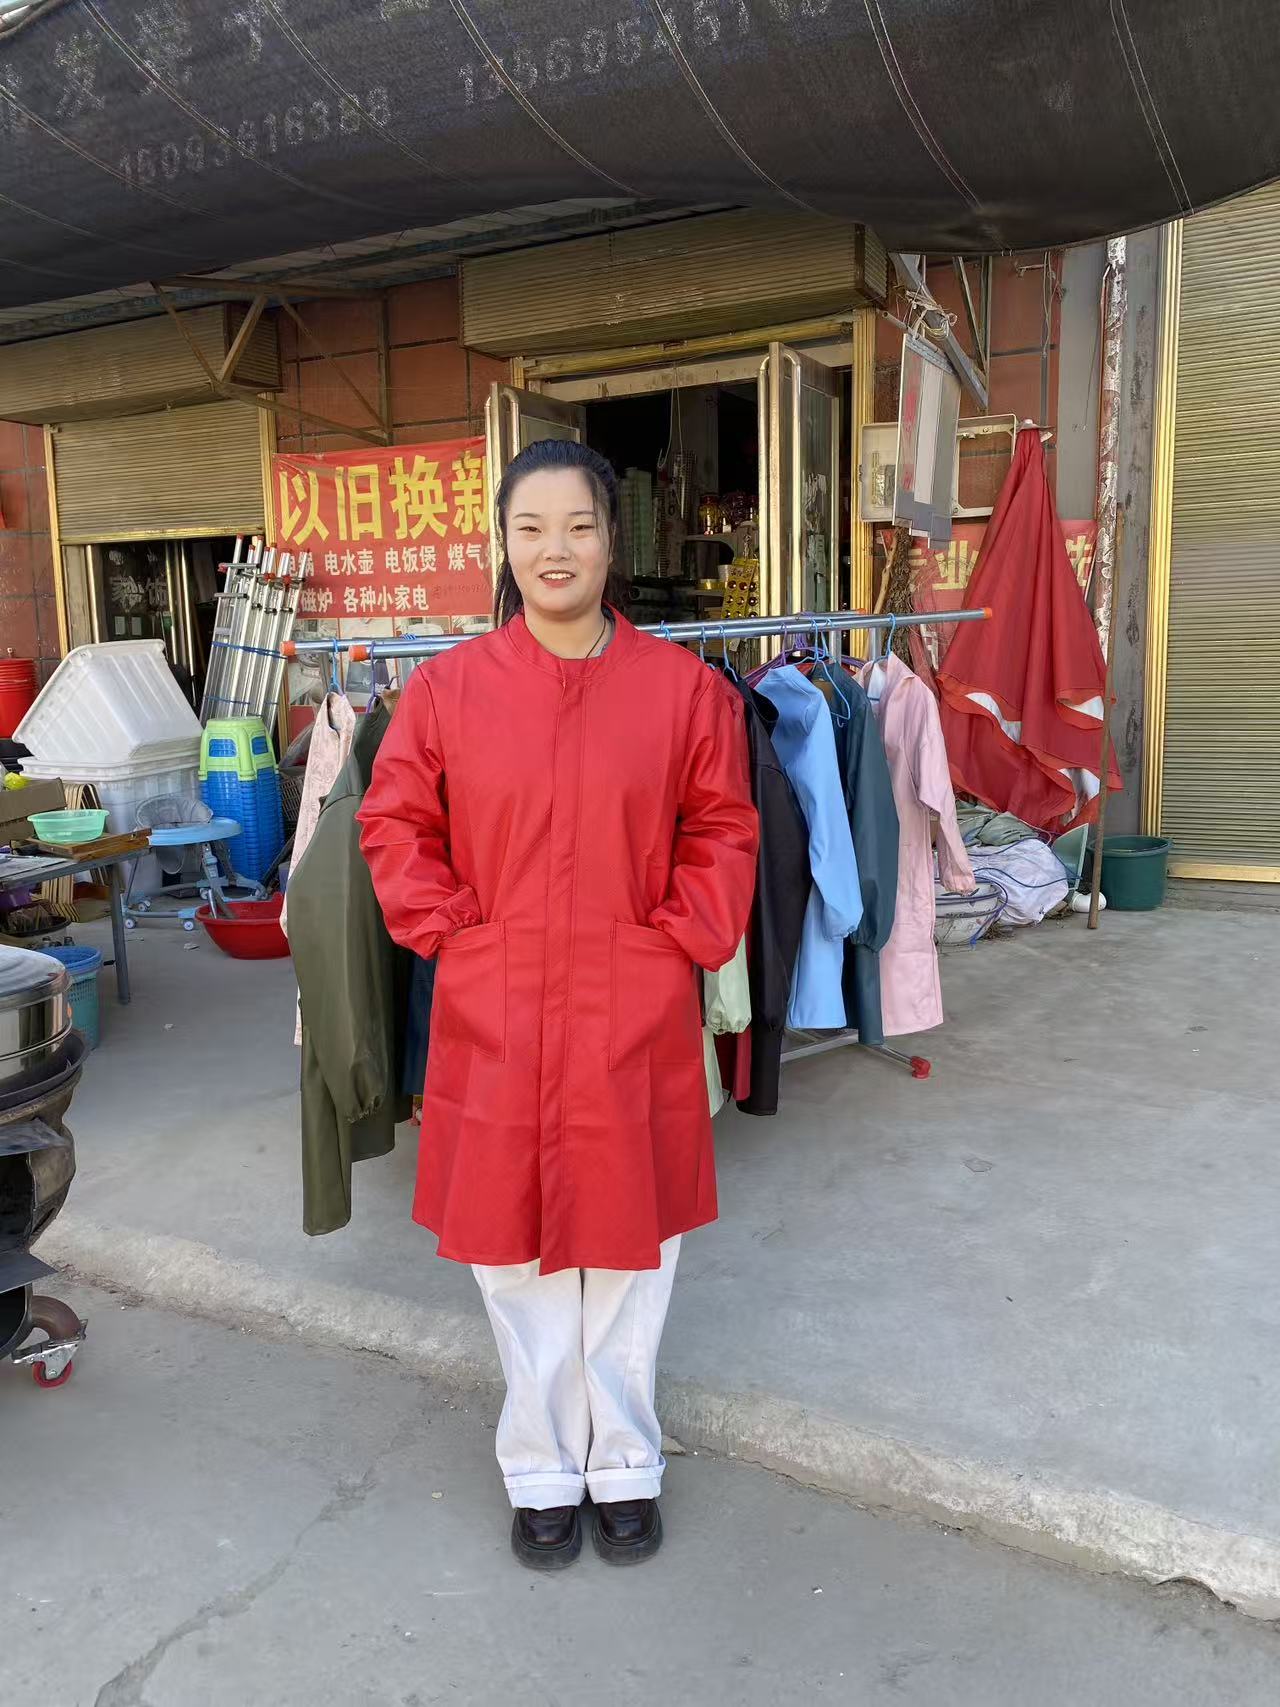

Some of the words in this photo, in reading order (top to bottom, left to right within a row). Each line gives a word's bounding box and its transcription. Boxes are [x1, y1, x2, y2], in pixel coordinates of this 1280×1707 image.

[279, 451, 489, 545] 以旧换新
[324, 548, 374, 576] 电水壶
[385, 545, 437, 574] 电饭煲
[295, 587, 333, 612] 磁炉
[343, 584, 429, 613] 各种小家电
